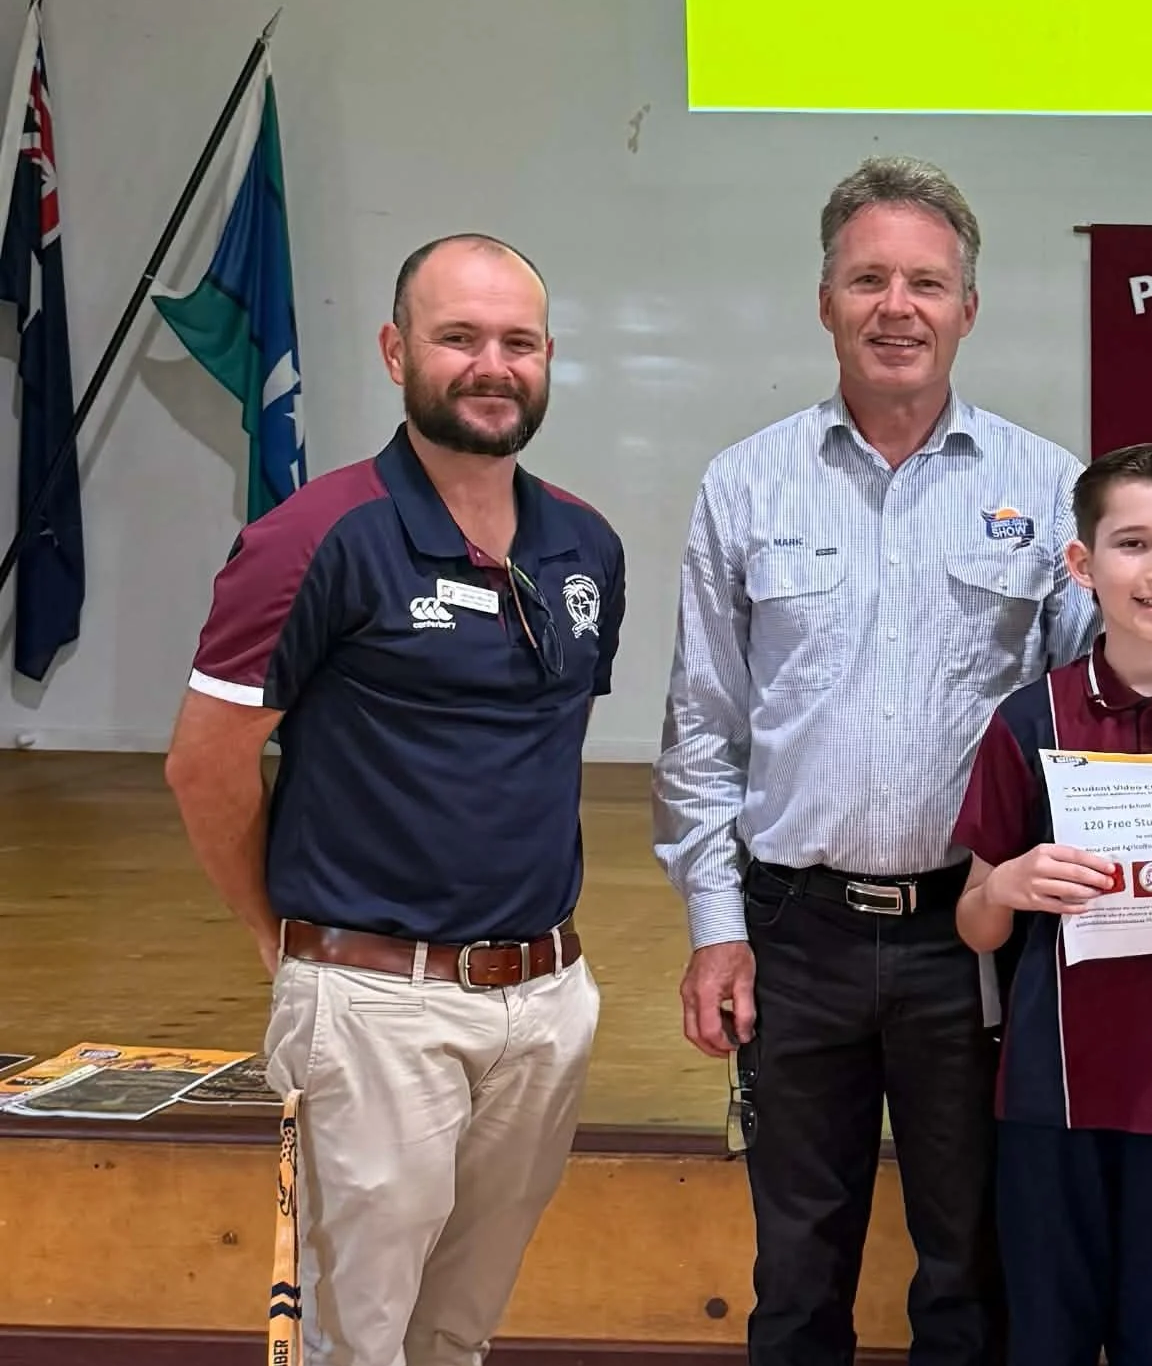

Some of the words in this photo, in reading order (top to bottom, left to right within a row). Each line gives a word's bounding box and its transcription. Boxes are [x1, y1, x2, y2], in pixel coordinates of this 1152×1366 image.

[992, 523, 1026, 538] SHOW
[773, 537, 803, 547] MARK
[1084, 820, 1104, 830] 120
[1107, 820, 1131, 829] Free
